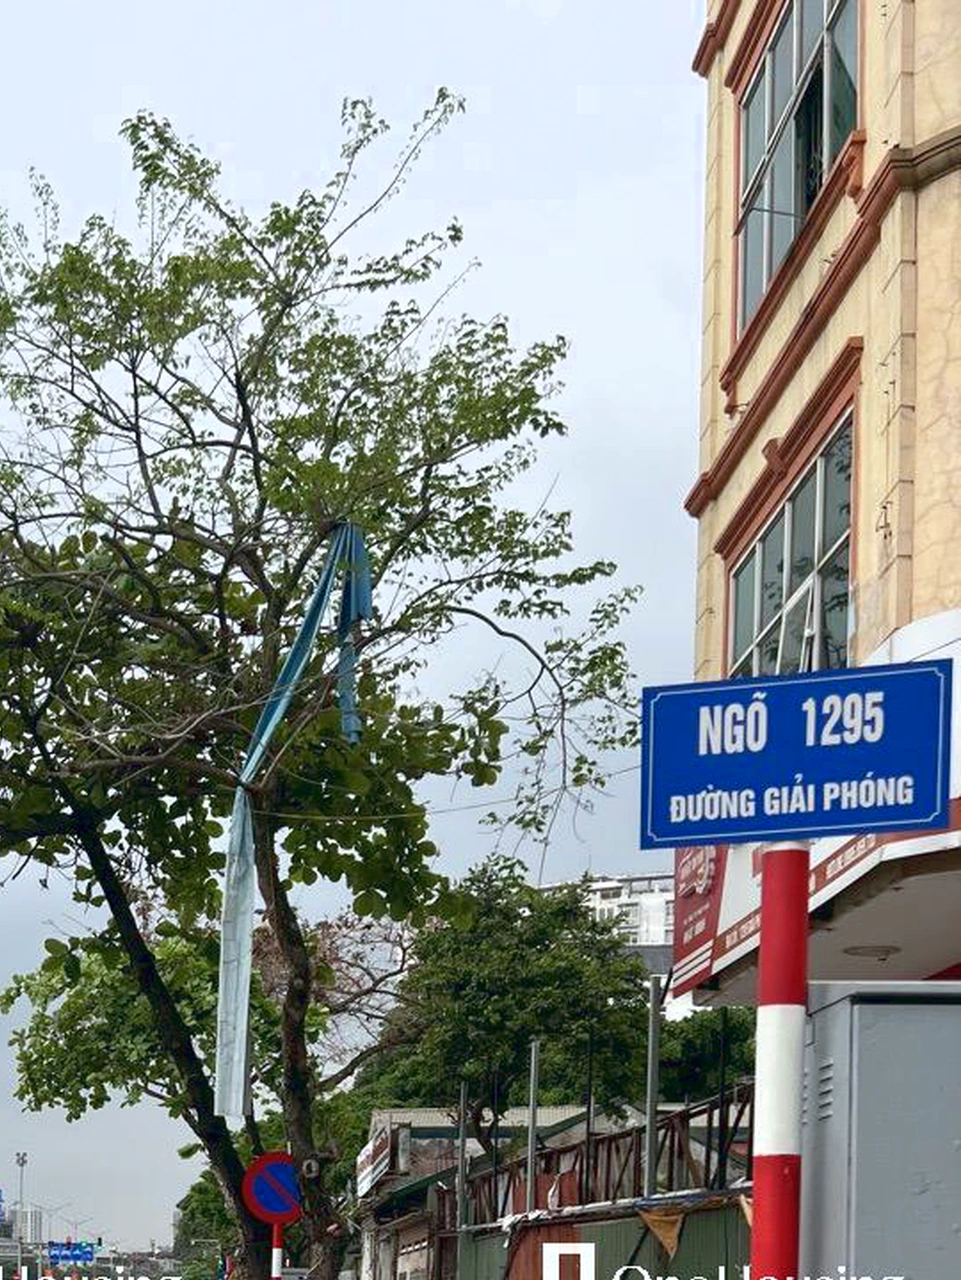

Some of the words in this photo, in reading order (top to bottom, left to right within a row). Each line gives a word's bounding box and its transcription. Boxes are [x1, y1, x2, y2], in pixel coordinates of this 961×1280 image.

[698, 691, 768, 756] NGÕ
[802, 691, 885, 747] 1295
[669, 783, 756, 823] ĐƯỜNG
[763, 773, 816, 816] GIẢI
[823, 771, 915, 811] PHÓNG
